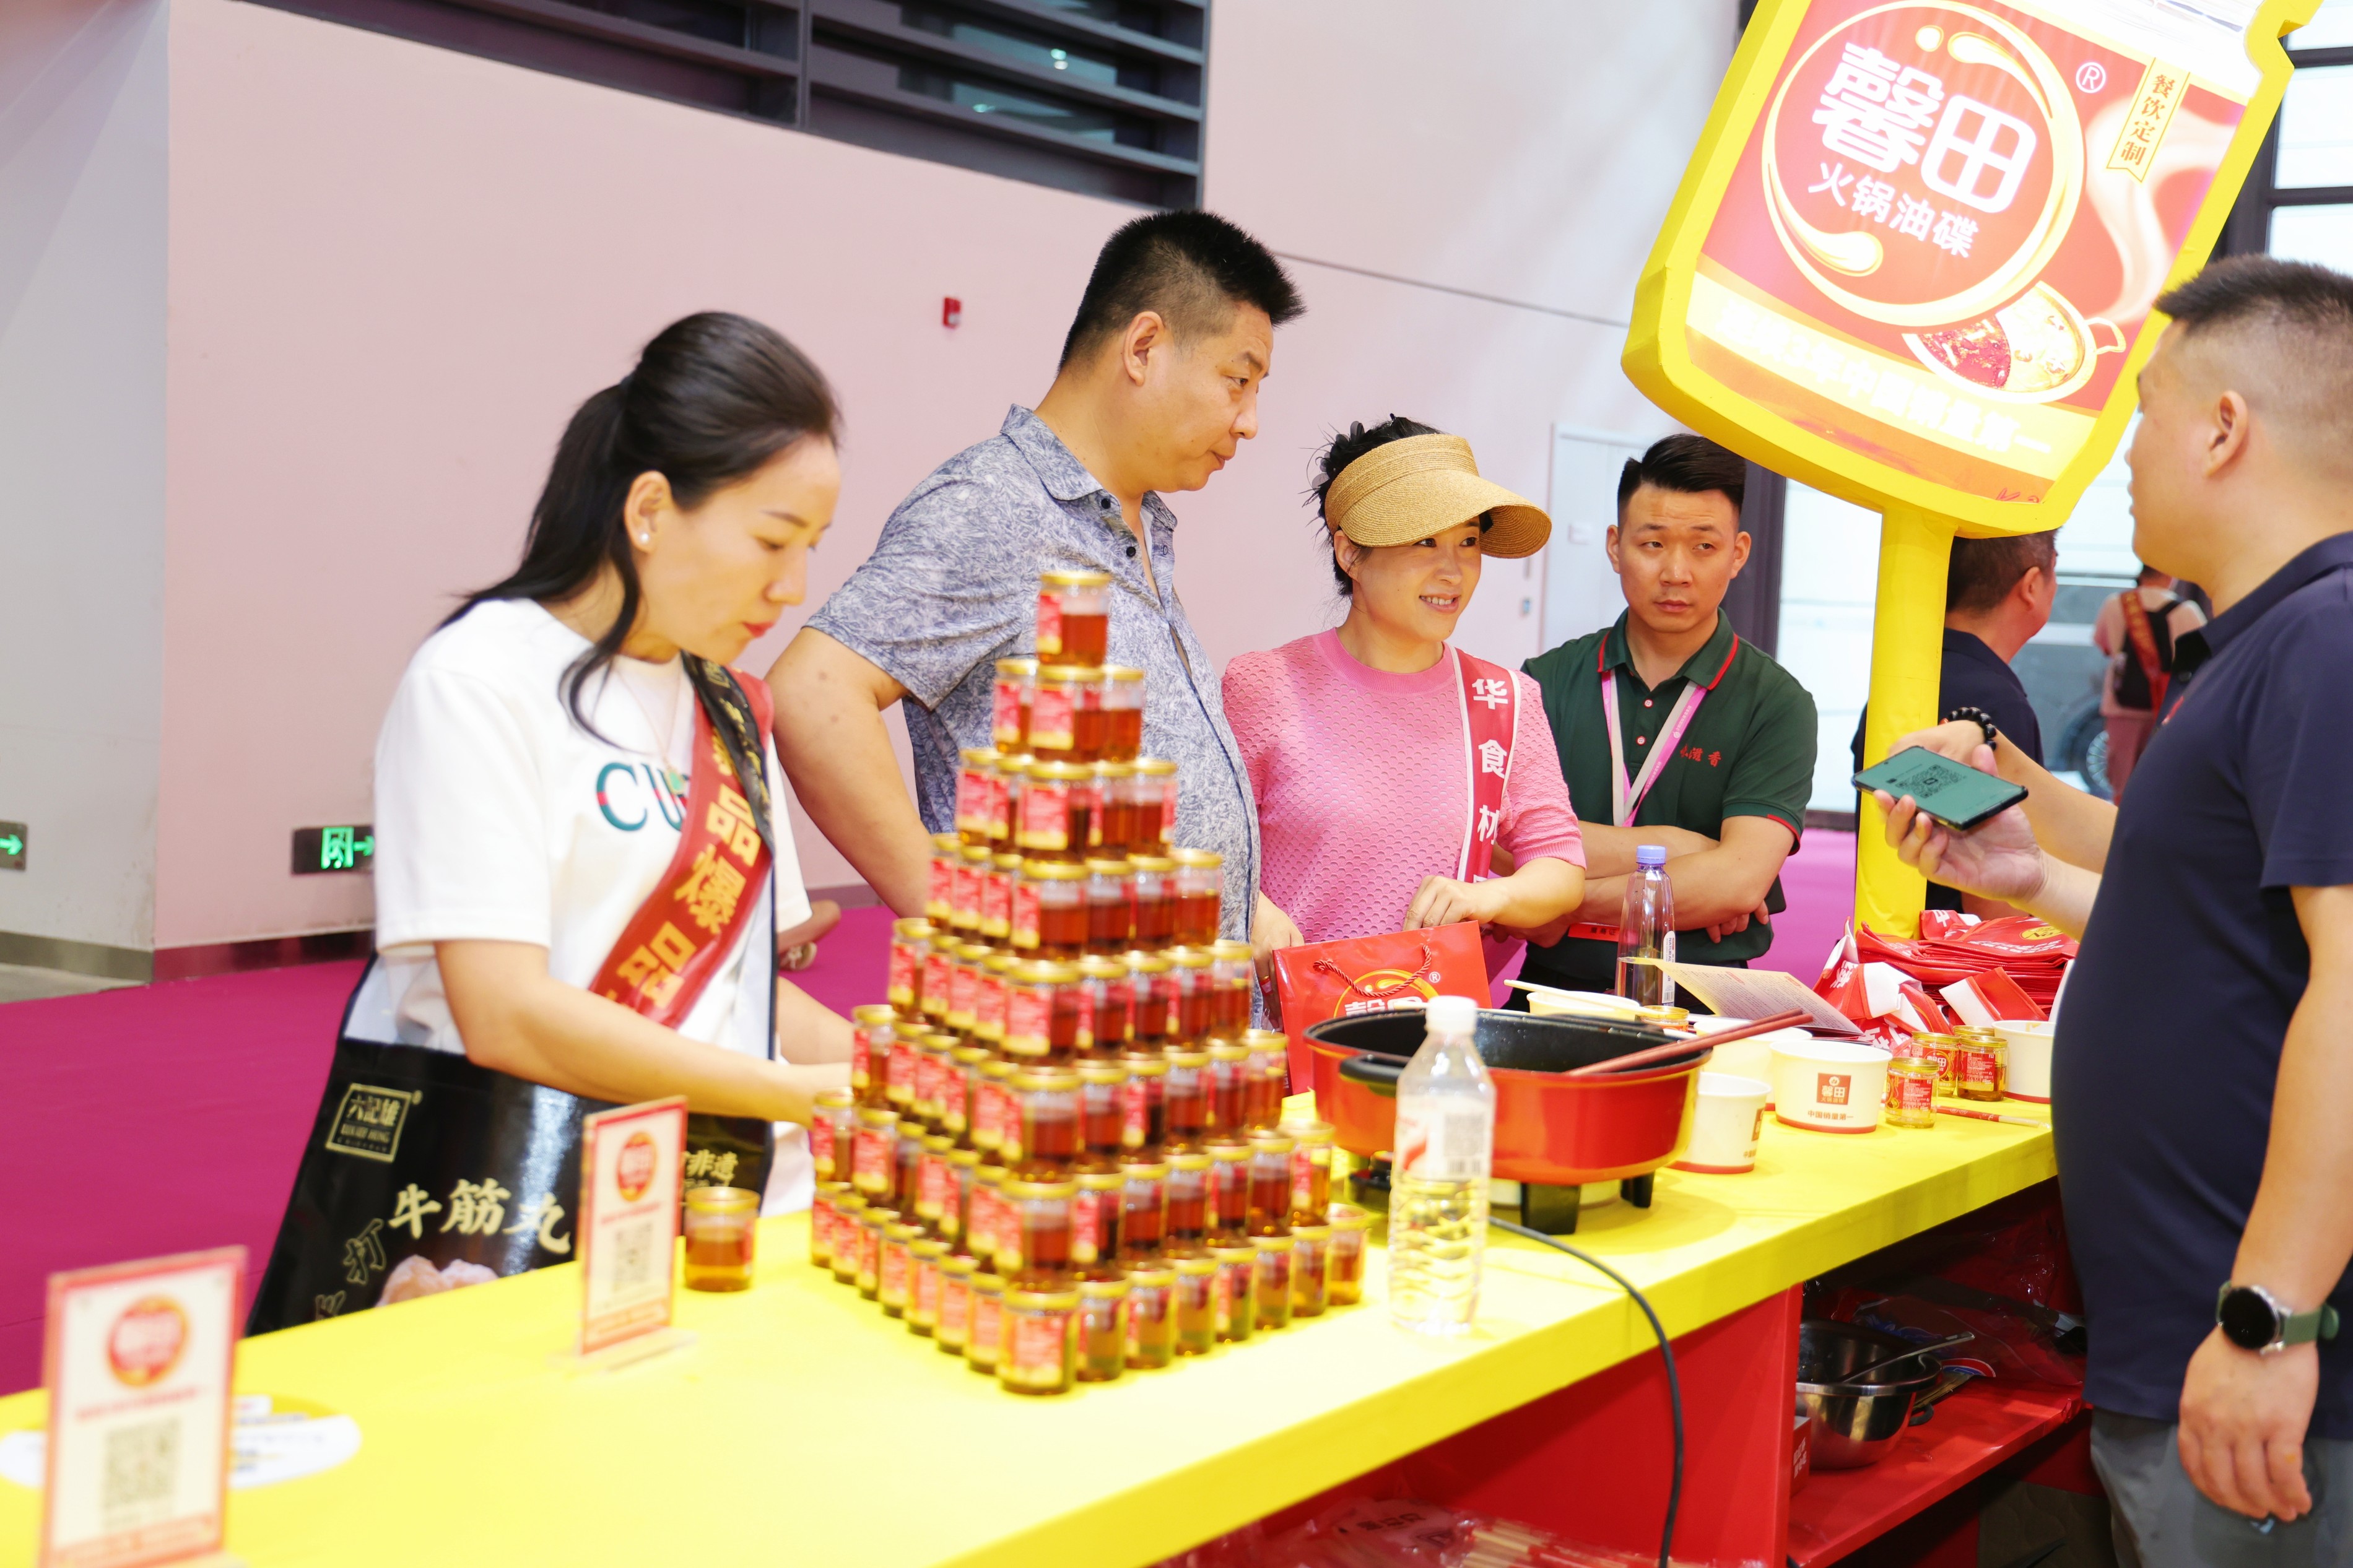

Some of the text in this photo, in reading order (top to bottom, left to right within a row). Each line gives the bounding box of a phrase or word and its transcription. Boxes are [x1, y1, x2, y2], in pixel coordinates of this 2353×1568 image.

[1812, 41, 2037, 214] 馨田
[2120, 74, 2176, 166] 餐饮定制
[1807, 162, 1979, 258] 火锅油碟
[596, 761, 689, 832] CU
[1471, 678, 1510, 883] 华食材
[610, 726, 762, 1018] 品爆品
[1807, 1110, 1854, 1120] 中国销量第一
[388, 1177, 572, 1255] 牛筋丸
